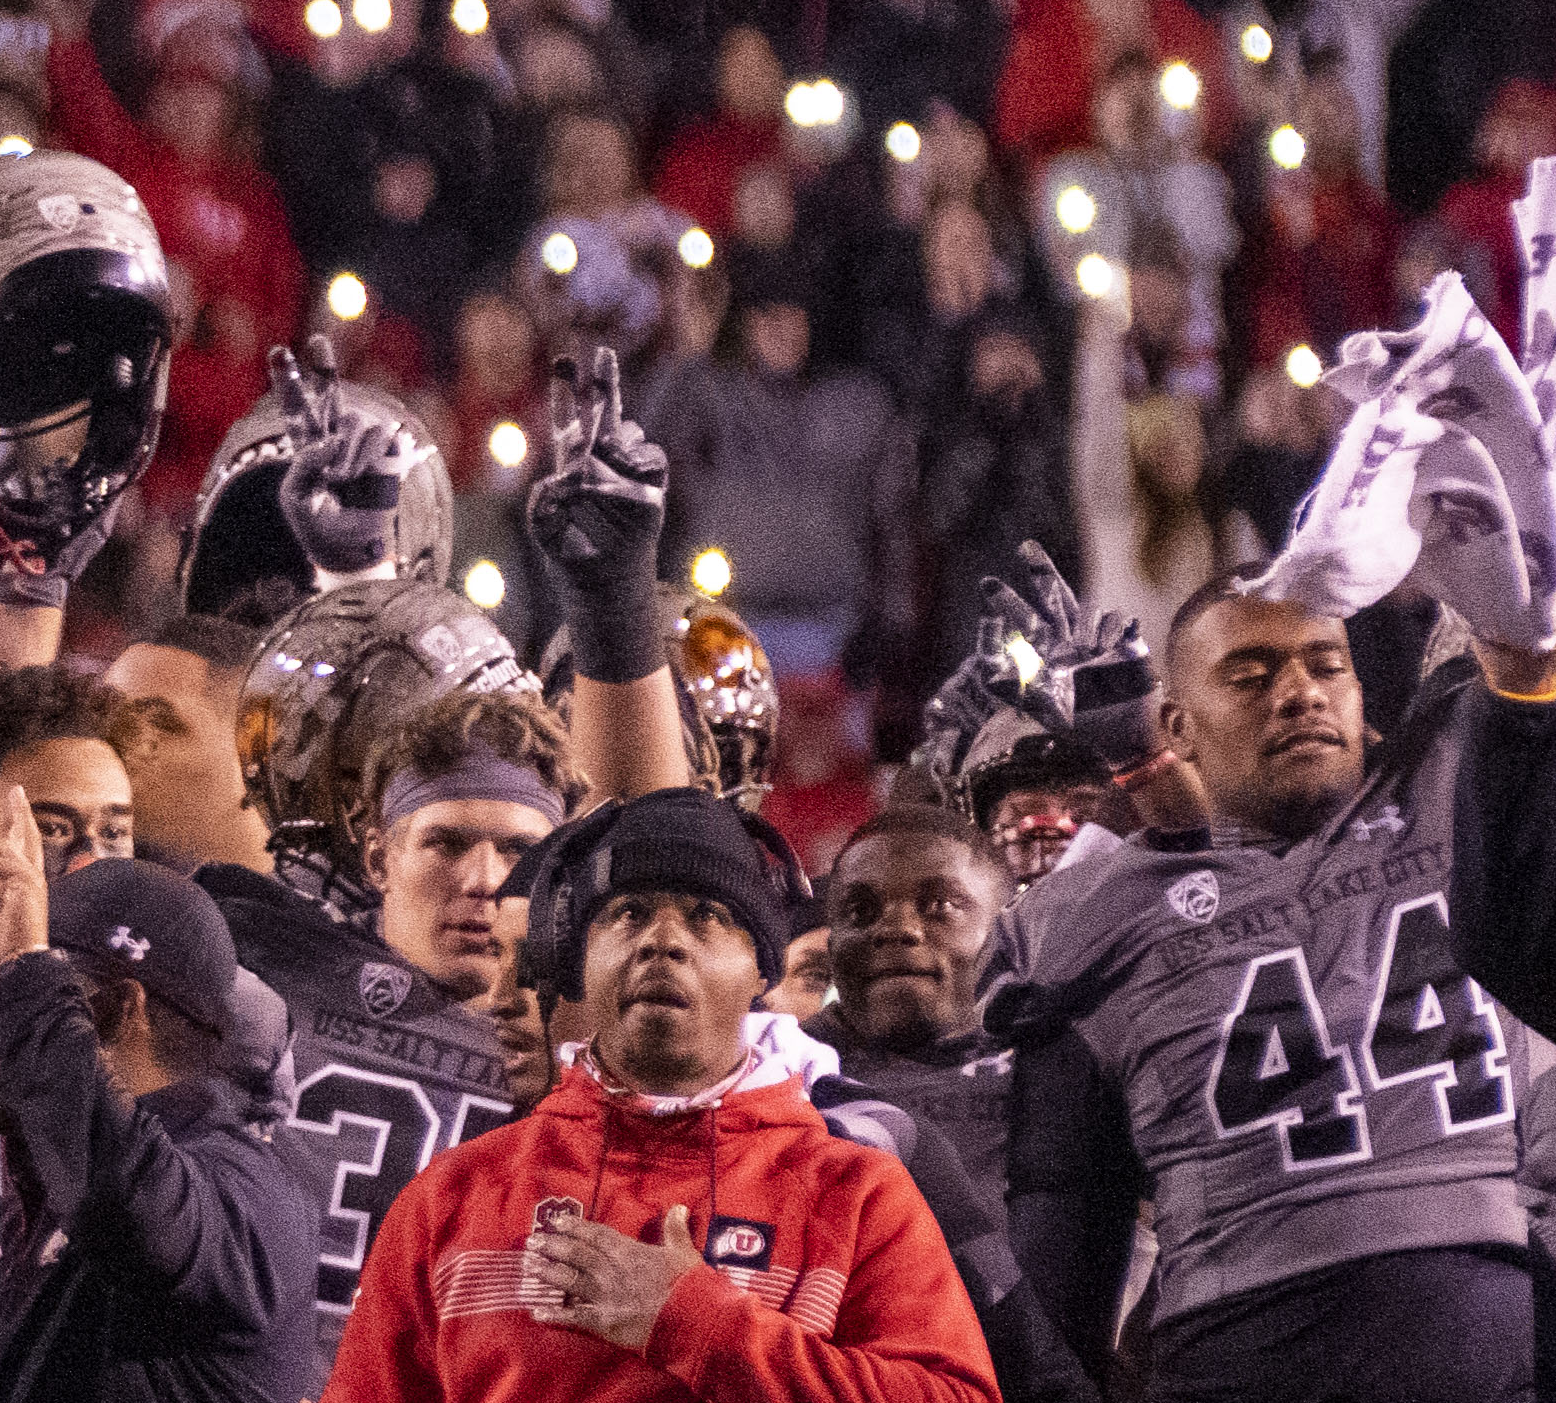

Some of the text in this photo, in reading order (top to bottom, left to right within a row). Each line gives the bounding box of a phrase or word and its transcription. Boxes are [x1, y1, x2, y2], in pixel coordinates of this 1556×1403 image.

[1217, 900, 1294, 940] SALT
[1298, 865, 1374, 912] LAKE
[1379, 844, 1444, 887] CITY
[313, 1007, 368, 1046] USS
[372, 1029, 452, 1073] SALT
[1204, 888, 1518, 1174] 44
[285, 1060, 515, 1315] 3
